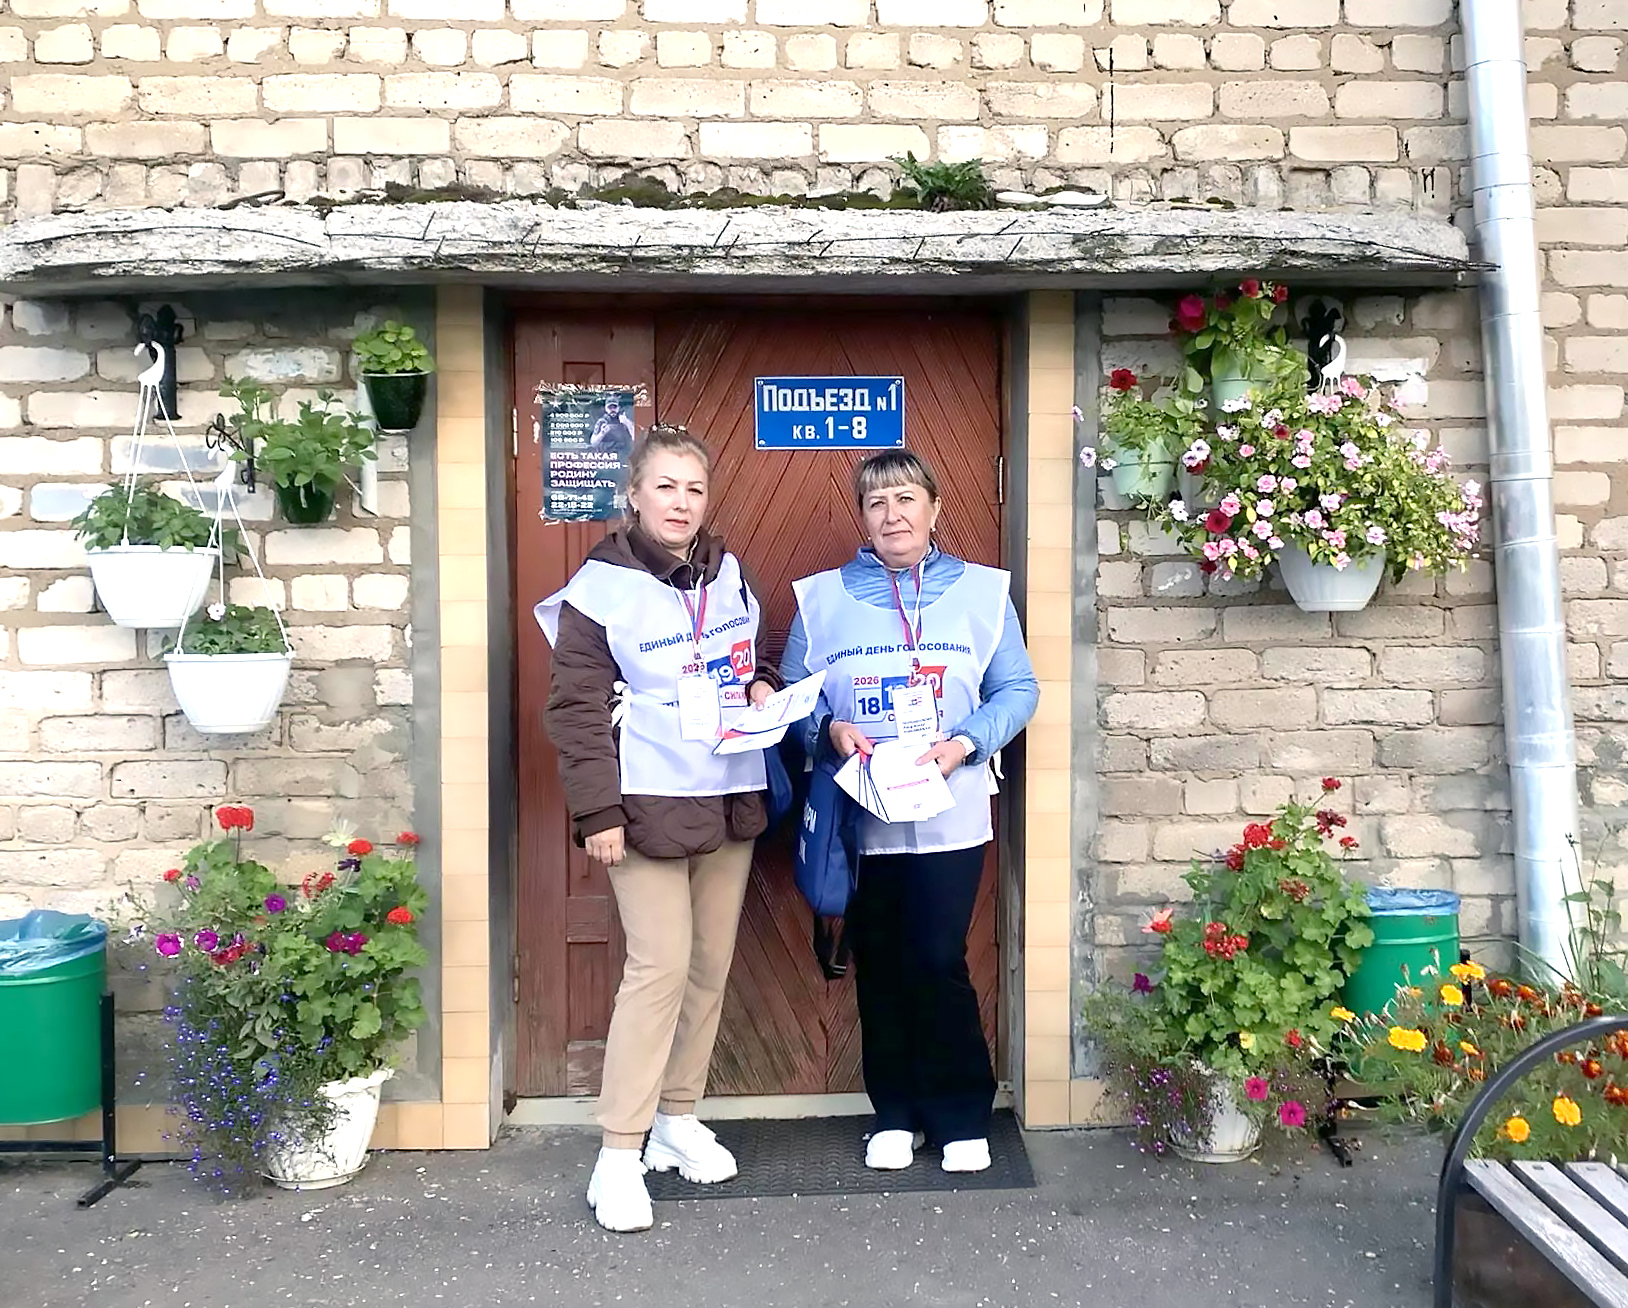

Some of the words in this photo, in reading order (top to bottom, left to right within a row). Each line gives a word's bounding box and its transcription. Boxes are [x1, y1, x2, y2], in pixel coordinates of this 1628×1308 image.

[550, 452, 579, 460] ЕСТЬ
[581, 452, 618, 460] ТАКАЯ
[550, 461, 621, 469] ПРОФЕССИЯ
[550, 470, 598, 479] РОДИНУ
[550, 480, 616, 488] ЗАЩИЩАТЬ
[639, 632, 684, 653] ЕДИНЫЙ
[826, 646, 863, 666] ЕДИНЫЙ
[865, 645, 895, 656] ДЕНЬ
[853, 676, 880, 686] 2026
[857, 697, 881, 715] 18
